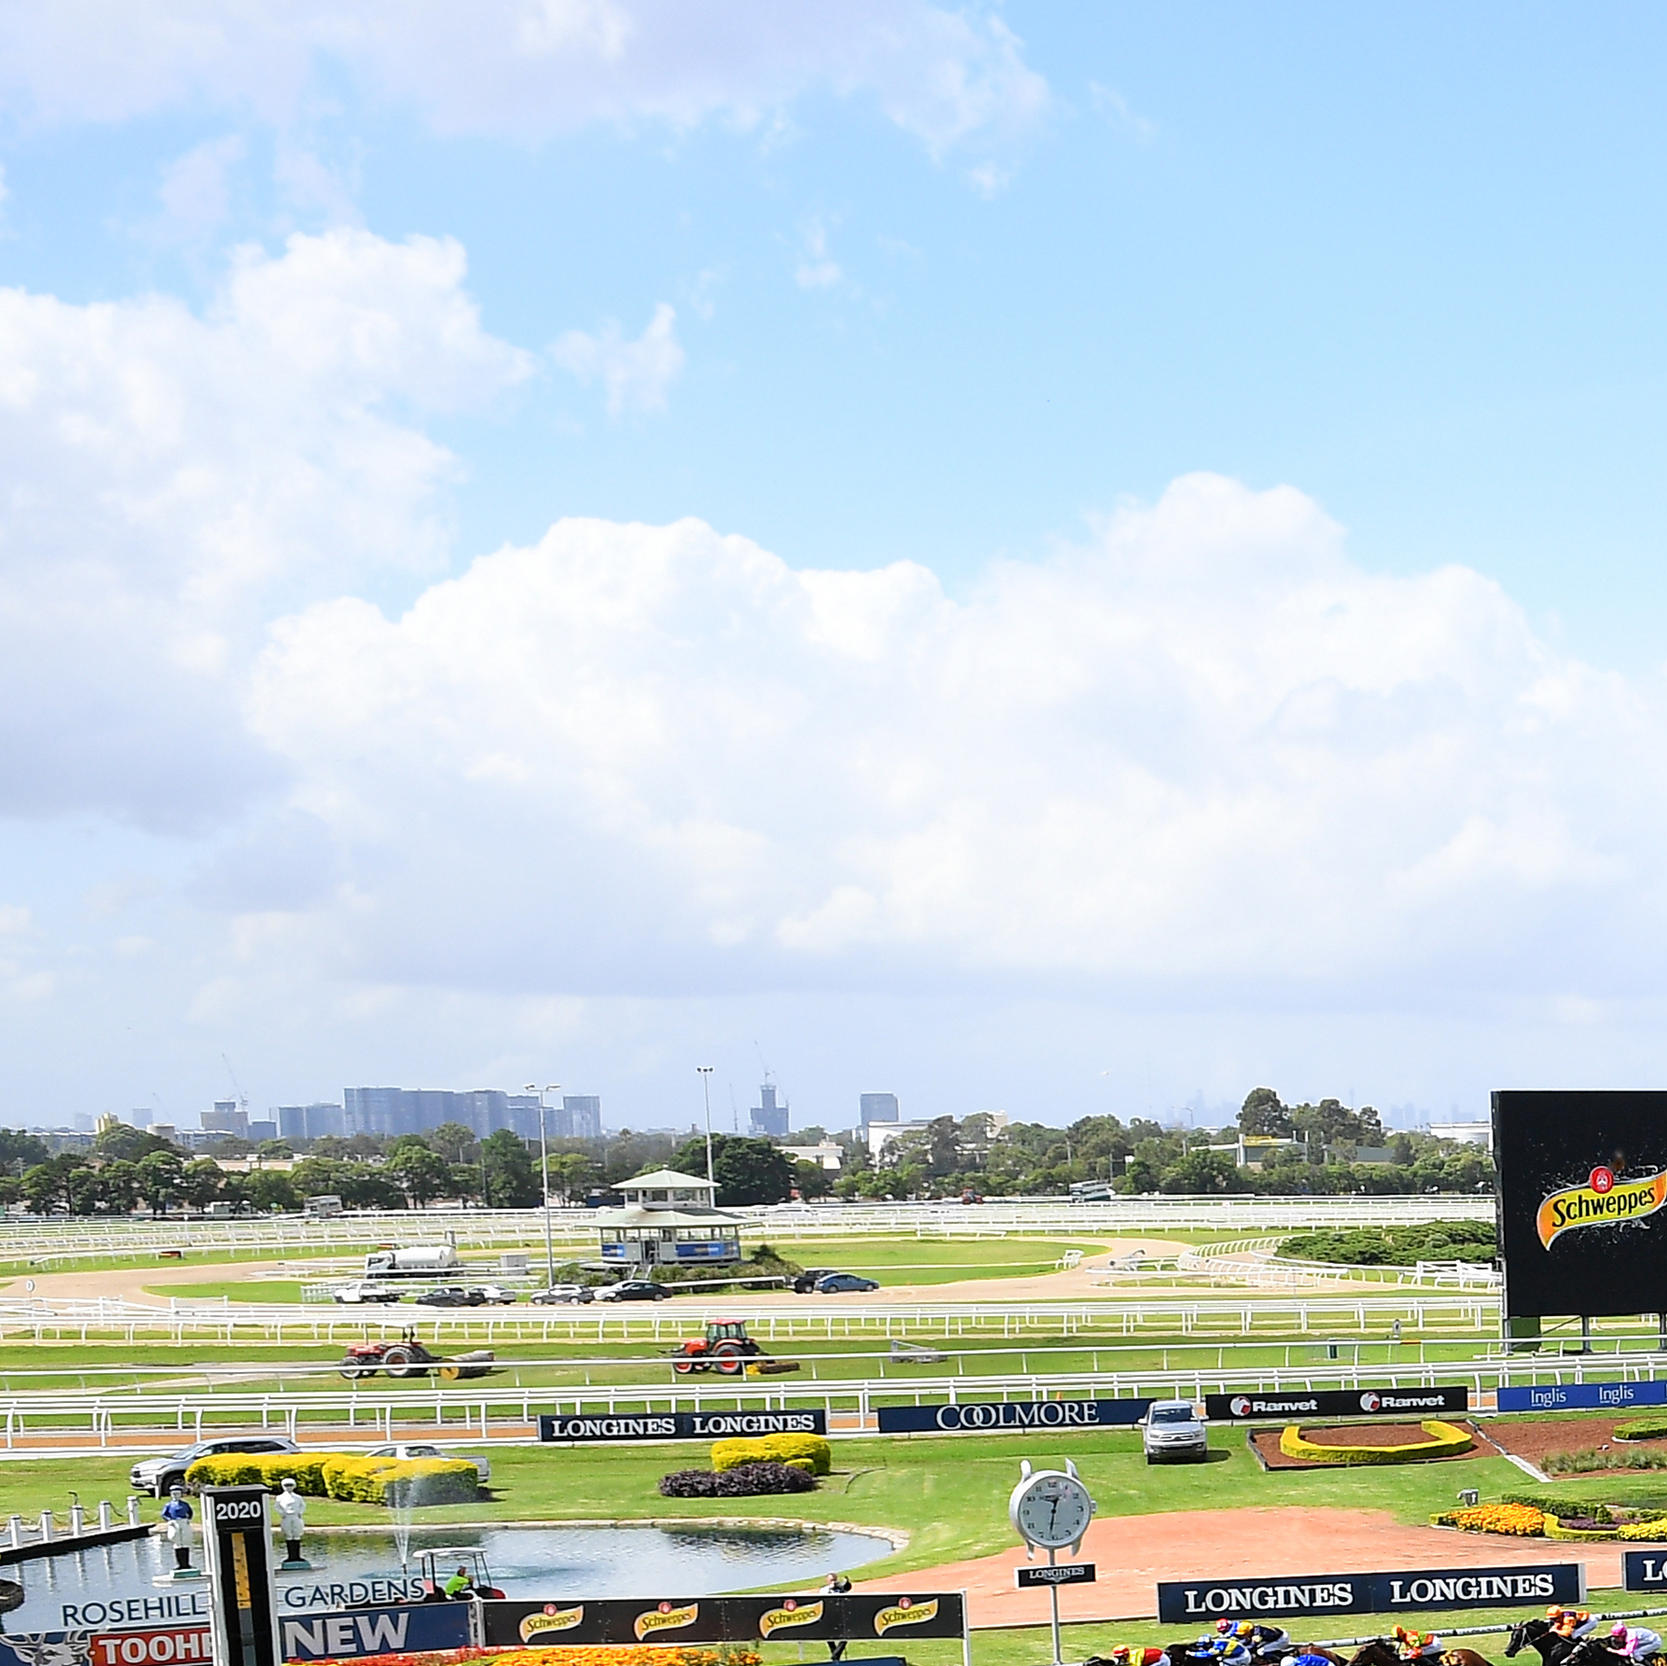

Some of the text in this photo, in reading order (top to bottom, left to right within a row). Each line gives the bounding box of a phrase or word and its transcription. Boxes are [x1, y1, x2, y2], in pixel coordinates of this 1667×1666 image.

[1552, 1187, 1655, 1228] Schweppes
[1253, 1397, 1318, 1413] Ranvet
[1382, 1393, 1445, 1409] Ranvet
[1531, 1388, 1567, 1407] Inglis
[1600, 1385, 1634, 1404] Inglis
[551, 1412, 816, 1438] LONGINES LONGINES
[936, 1402, 1100, 1431] COOLMORE
[216, 1501, 262, 1520] 2020
[1029, 1567, 1085, 1579] LONGINES
[62, 1579, 426, 1627] ROSEHILL GARDENS
[1185, 1573, 1555, 1612] LONGINES LONGINES
[527, 1613, 578, 1633] Schweppes
[642, 1610, 692, 1631] Schweppes
[767, 1607, 819, 1629] Schweppes
[881, 1605, 933, 1626] Schweppes
[98, 1612, 411, 1665] TOOHE NEW
